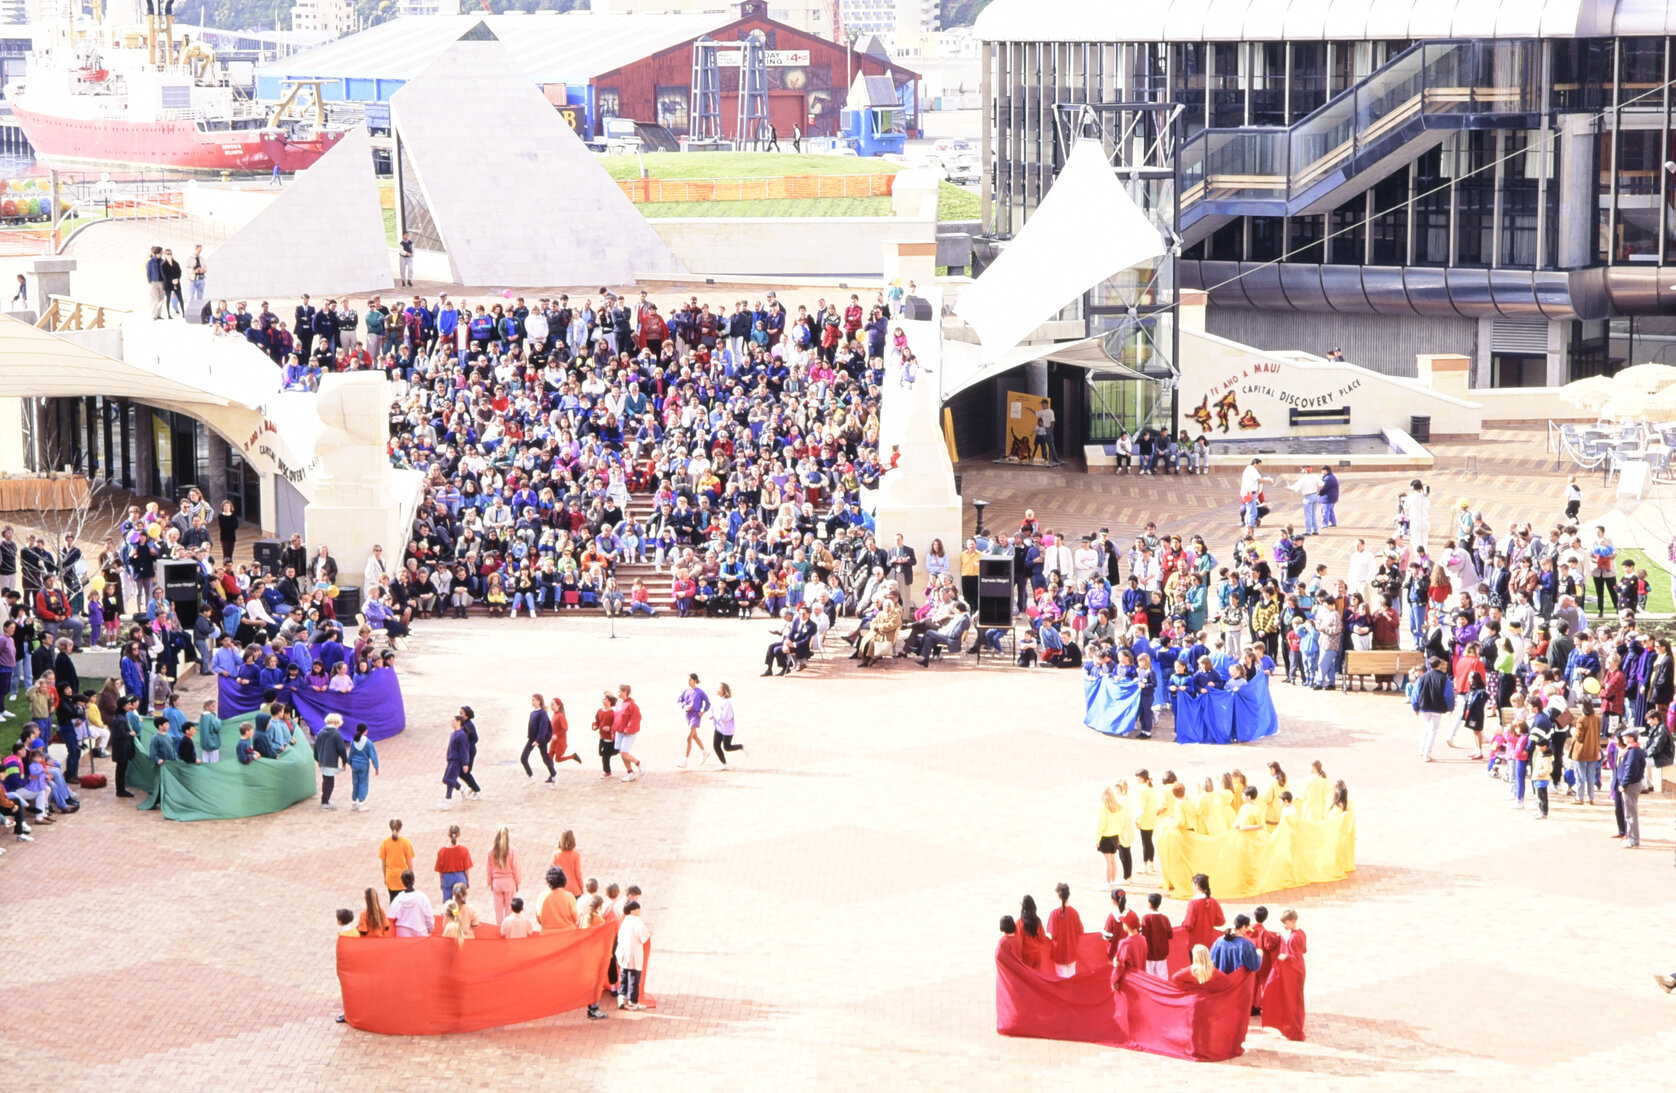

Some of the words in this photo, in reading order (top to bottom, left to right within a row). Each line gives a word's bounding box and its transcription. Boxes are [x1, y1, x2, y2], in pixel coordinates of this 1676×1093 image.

[1210, 388, 1219, 396] TE
[1223, 375, 1239, 390] AHO
[1243, 370, 1249, 378] A
[1254, 363, 1281, 374] MAUI
[1242, 385, 1275, 398] CAPITAL
[1279, 391, 1333, 408] DISCOVERY
[1339, 378, 1361, 397] PLACE
